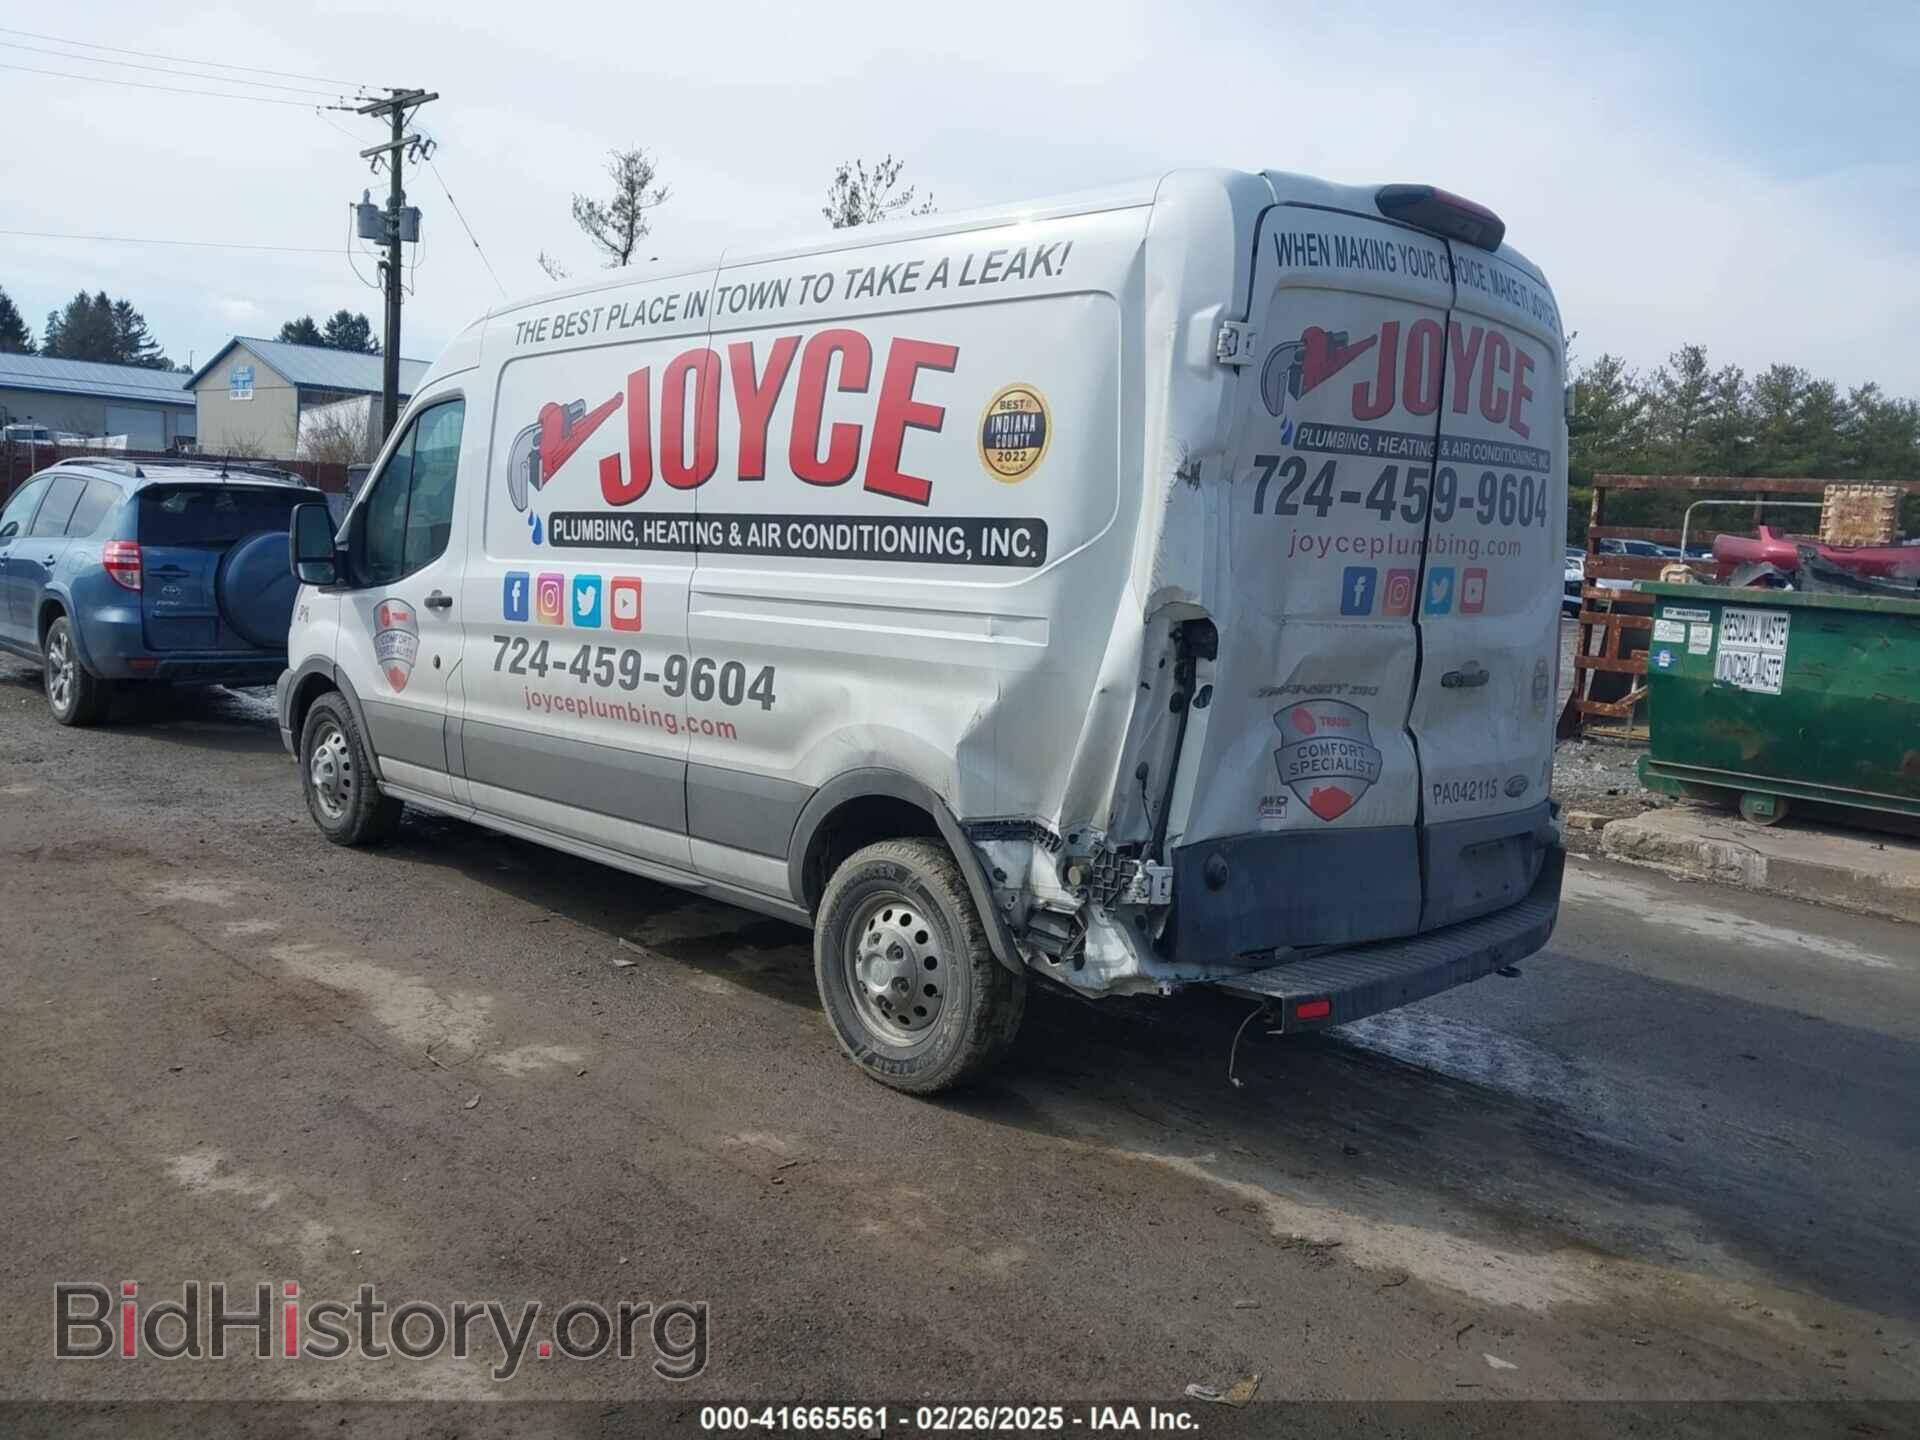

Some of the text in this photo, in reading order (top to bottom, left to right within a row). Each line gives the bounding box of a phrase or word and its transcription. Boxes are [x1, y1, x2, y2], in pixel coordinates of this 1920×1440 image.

[1274, 232, 1330, 267] WHEN
[1334, 234, 1397, 273] MAKING
[1399, 243, 1438, 281] YOUR
[1489, 267, 1521, 306] MAKE
[514, 240, 1073, 346] THE BEST PLACE IN TOWN TO TAKE A LEAK!
[1351, 318, 1535, 441] JOYCE
[599, 328, 960, 508] JOYCE
[1000, 399, 1025, 410] BEST
[990, 414, 1037, 433] INDIANA
[994, 432, 1032, 449] COUNTY
[996, 450, 1028, 462] 2022
[1299, 427, 1373, 451] PLUMBING,
[1376, 437, 1436, 459] HEATING
[1441, 440, 1450, 457] &
[1451, 442, 1471, 459] AIR
[1252, 454, 1548, 528] 724-459-9604
[553, 519, 1037, 560] PLUMBING, HEATING & AIR CONDITIONING, INC.
[1288, 528, 1521, 560] joyceplumbing.com
[492, 634, 776, 711] 724-459-9604
[523, 686, 738, 740] joyceplumbing.com
[1288, 757, 1377, 776] SPECIALIST
[1296, 742, 1366, 760] COMFORT
[1432, 779, 1498, 805] PA042115
